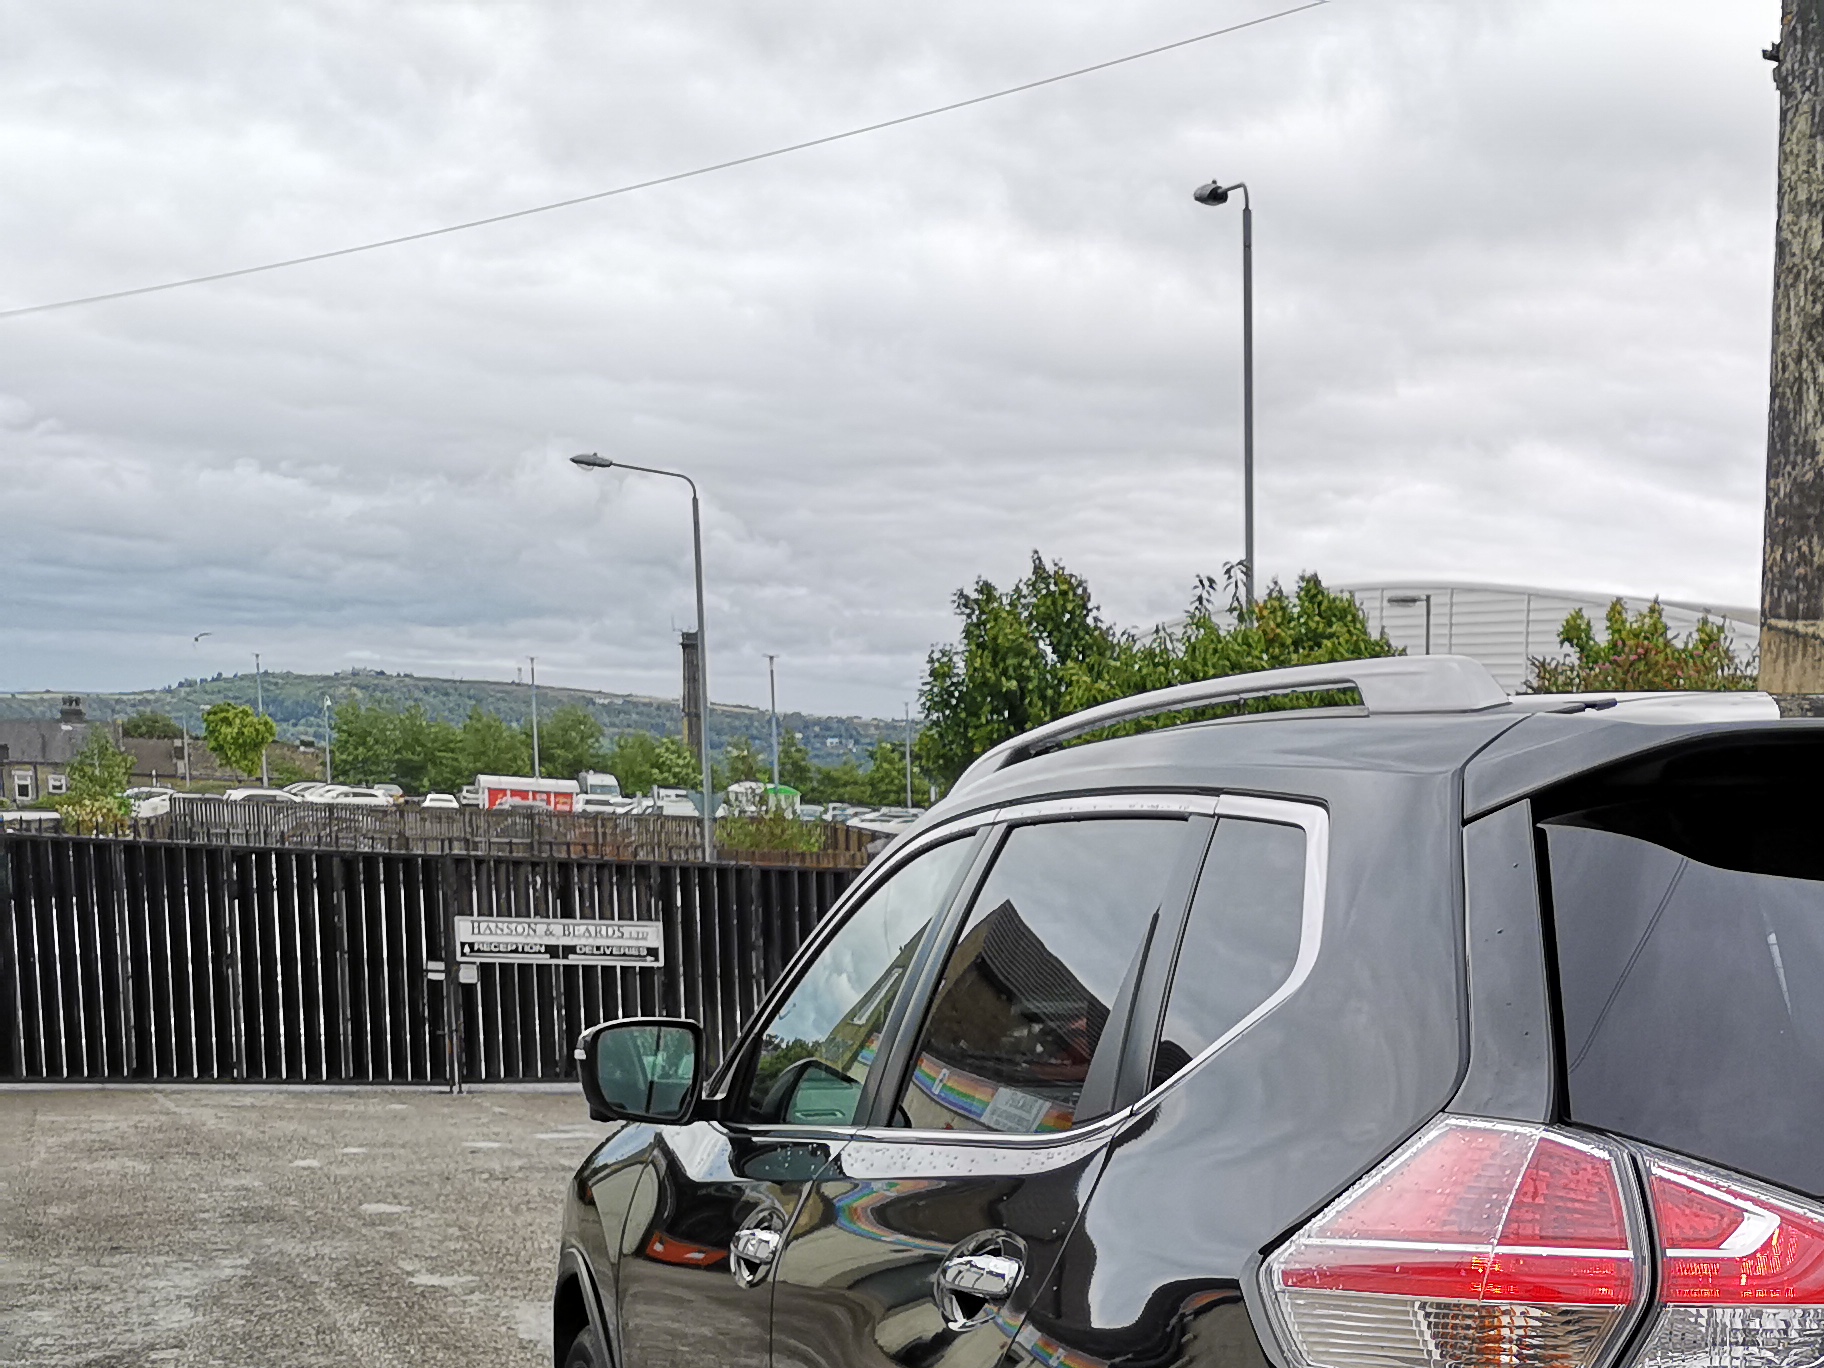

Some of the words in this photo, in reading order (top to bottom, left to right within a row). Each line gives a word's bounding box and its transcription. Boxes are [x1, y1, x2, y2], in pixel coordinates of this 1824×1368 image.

[471, 921, 537, 936] HANSON
[545, 924, 555, 936] &
[562, 924, 625, 938] BEARDS
[474, 942, 545, 953] RECEPTION
[576, 945, 647, 956] DELIVERIES
